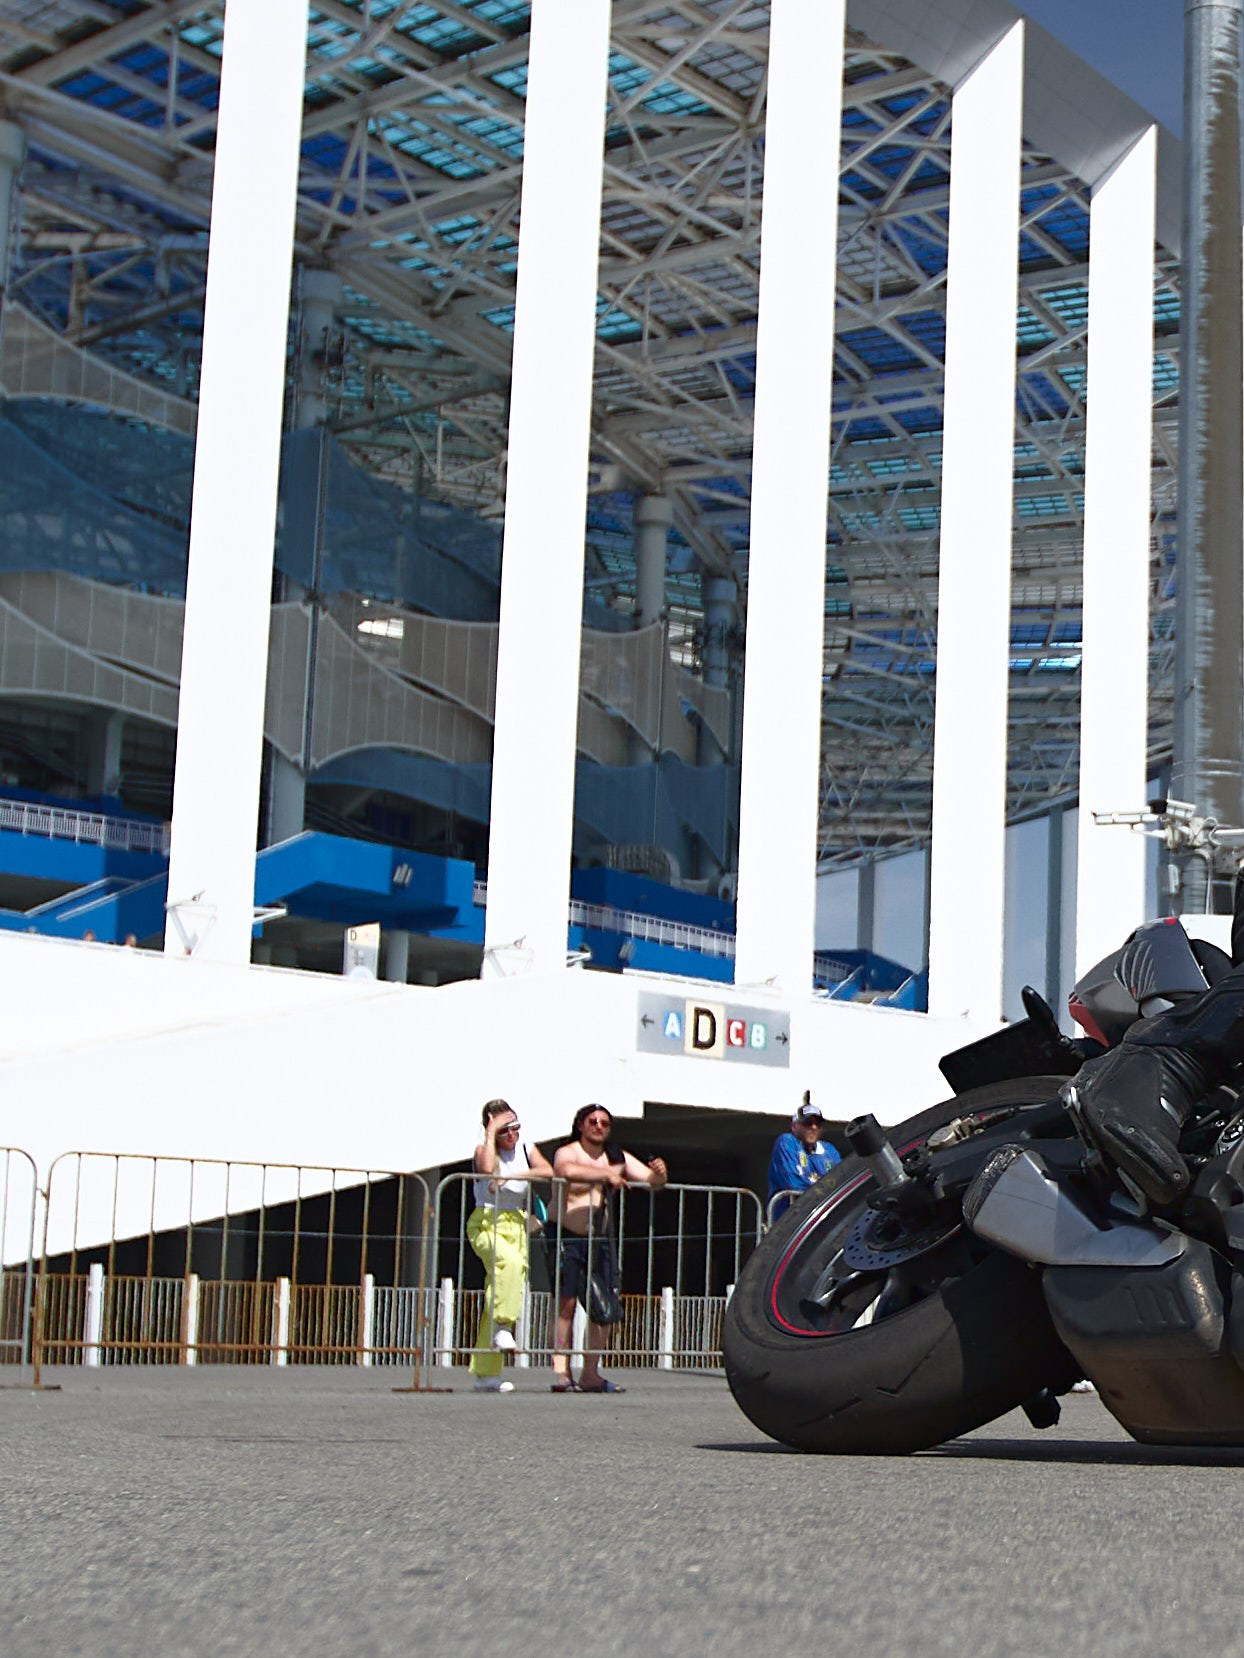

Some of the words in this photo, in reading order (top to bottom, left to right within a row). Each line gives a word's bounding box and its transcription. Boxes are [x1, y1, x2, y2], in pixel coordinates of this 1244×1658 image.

[664, 1012, 681, 1038] A
[692, 1006, 716, 1050] D
[729, 1021, 743, 1046] C
[751, 1024, 765, 1048] B
